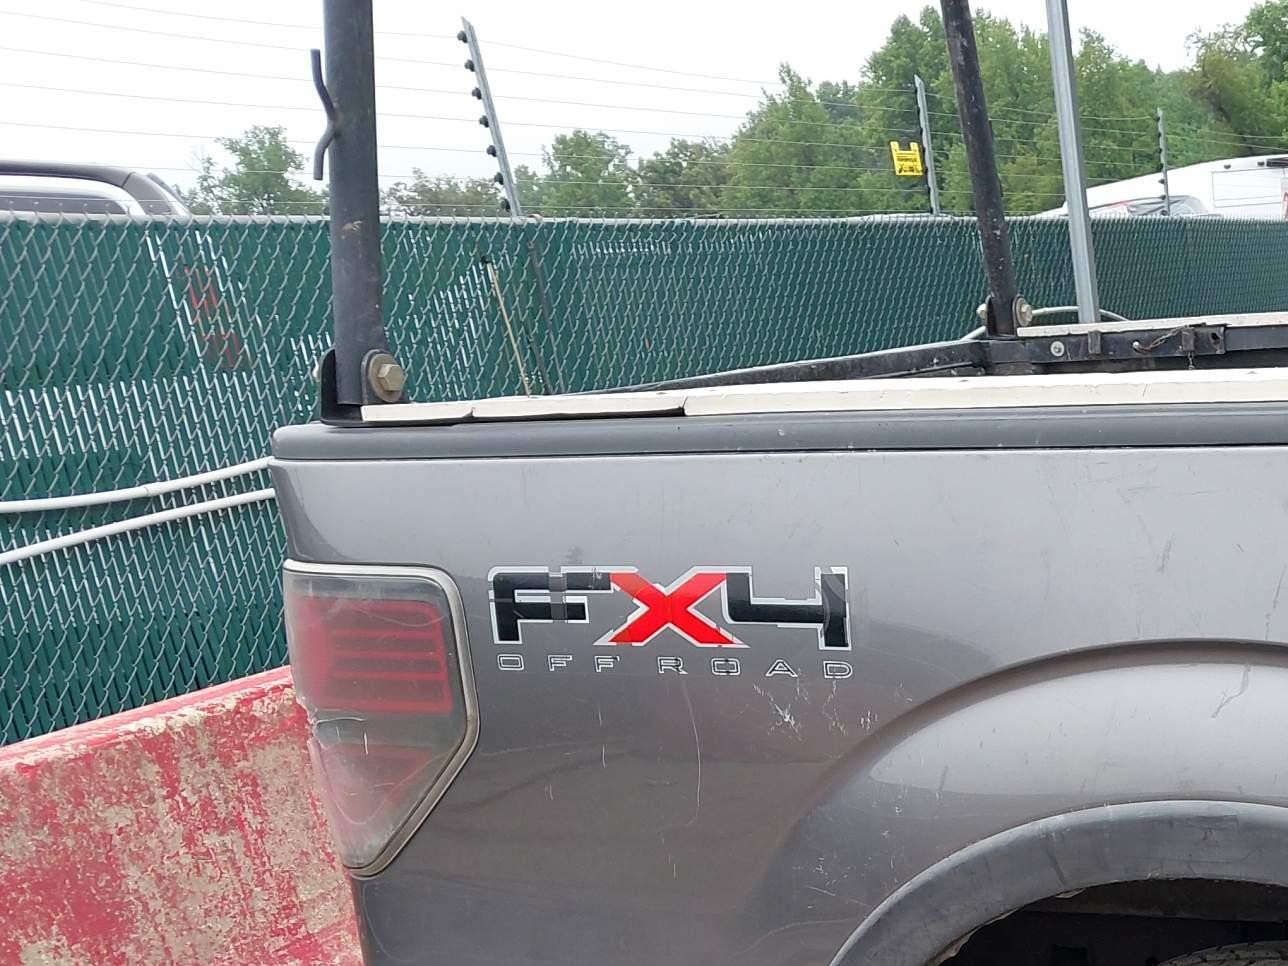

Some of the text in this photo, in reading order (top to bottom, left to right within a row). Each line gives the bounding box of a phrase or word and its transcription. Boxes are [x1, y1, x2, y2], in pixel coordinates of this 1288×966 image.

[488, 565, 852, 651] FX4
[497, 653, 853, 679] OFF ROAD
